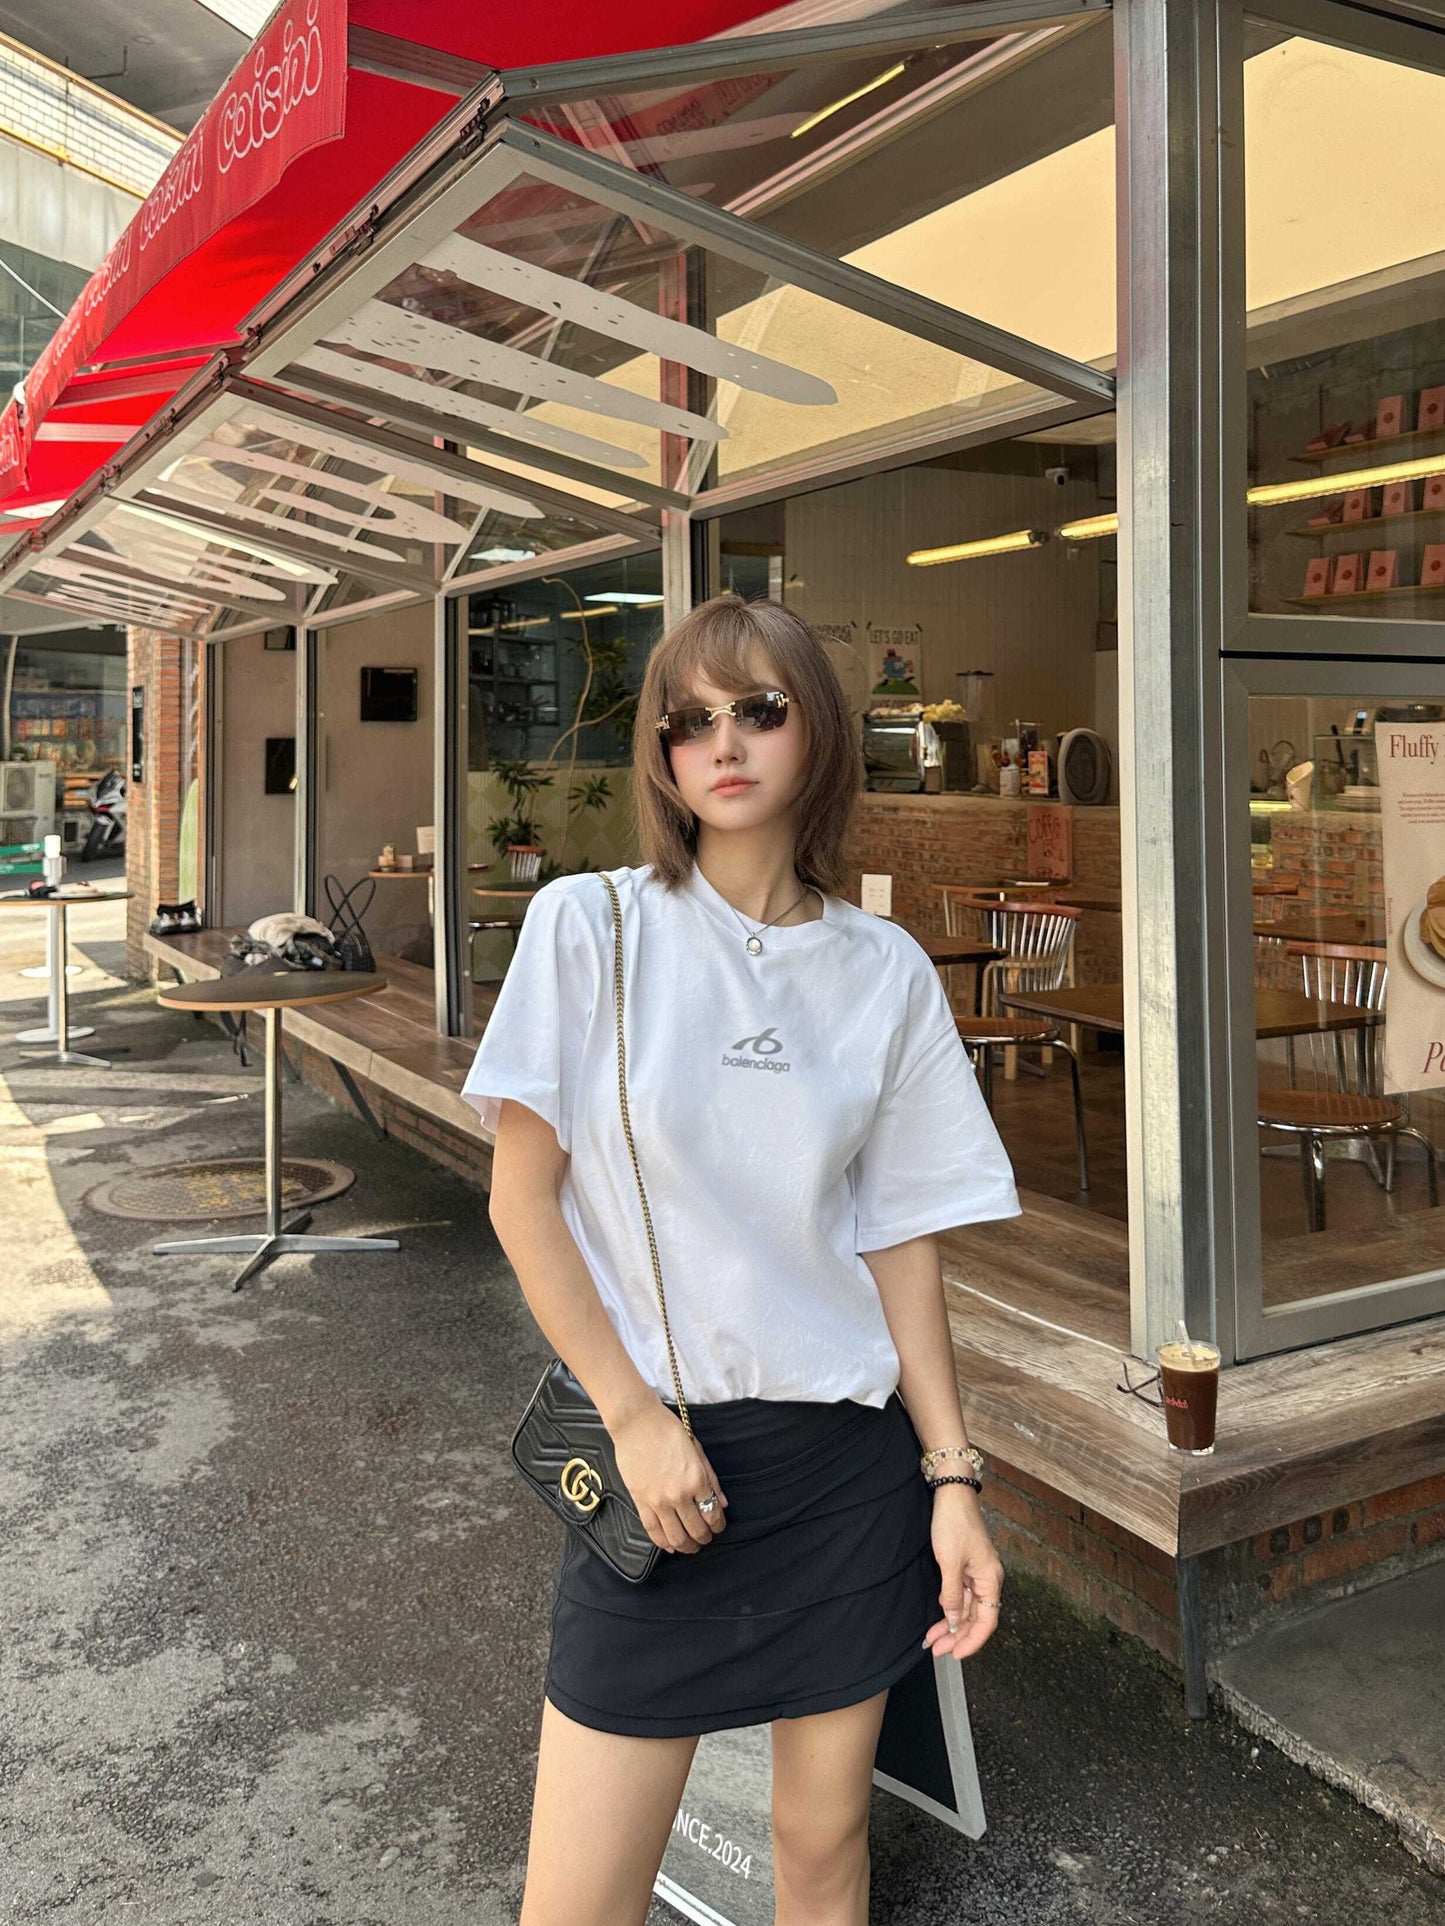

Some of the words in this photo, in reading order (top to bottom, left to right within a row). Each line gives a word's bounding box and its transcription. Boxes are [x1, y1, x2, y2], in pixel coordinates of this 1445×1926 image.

[892, 630, 904, 645] GO
[905, 630, 919, 645] EAT
[1389, 734, 1439, 765] Fluffy
[721, 1054, 791, 1074] balenciaga
[672, 1808, 752, 1880] NCE.2024
